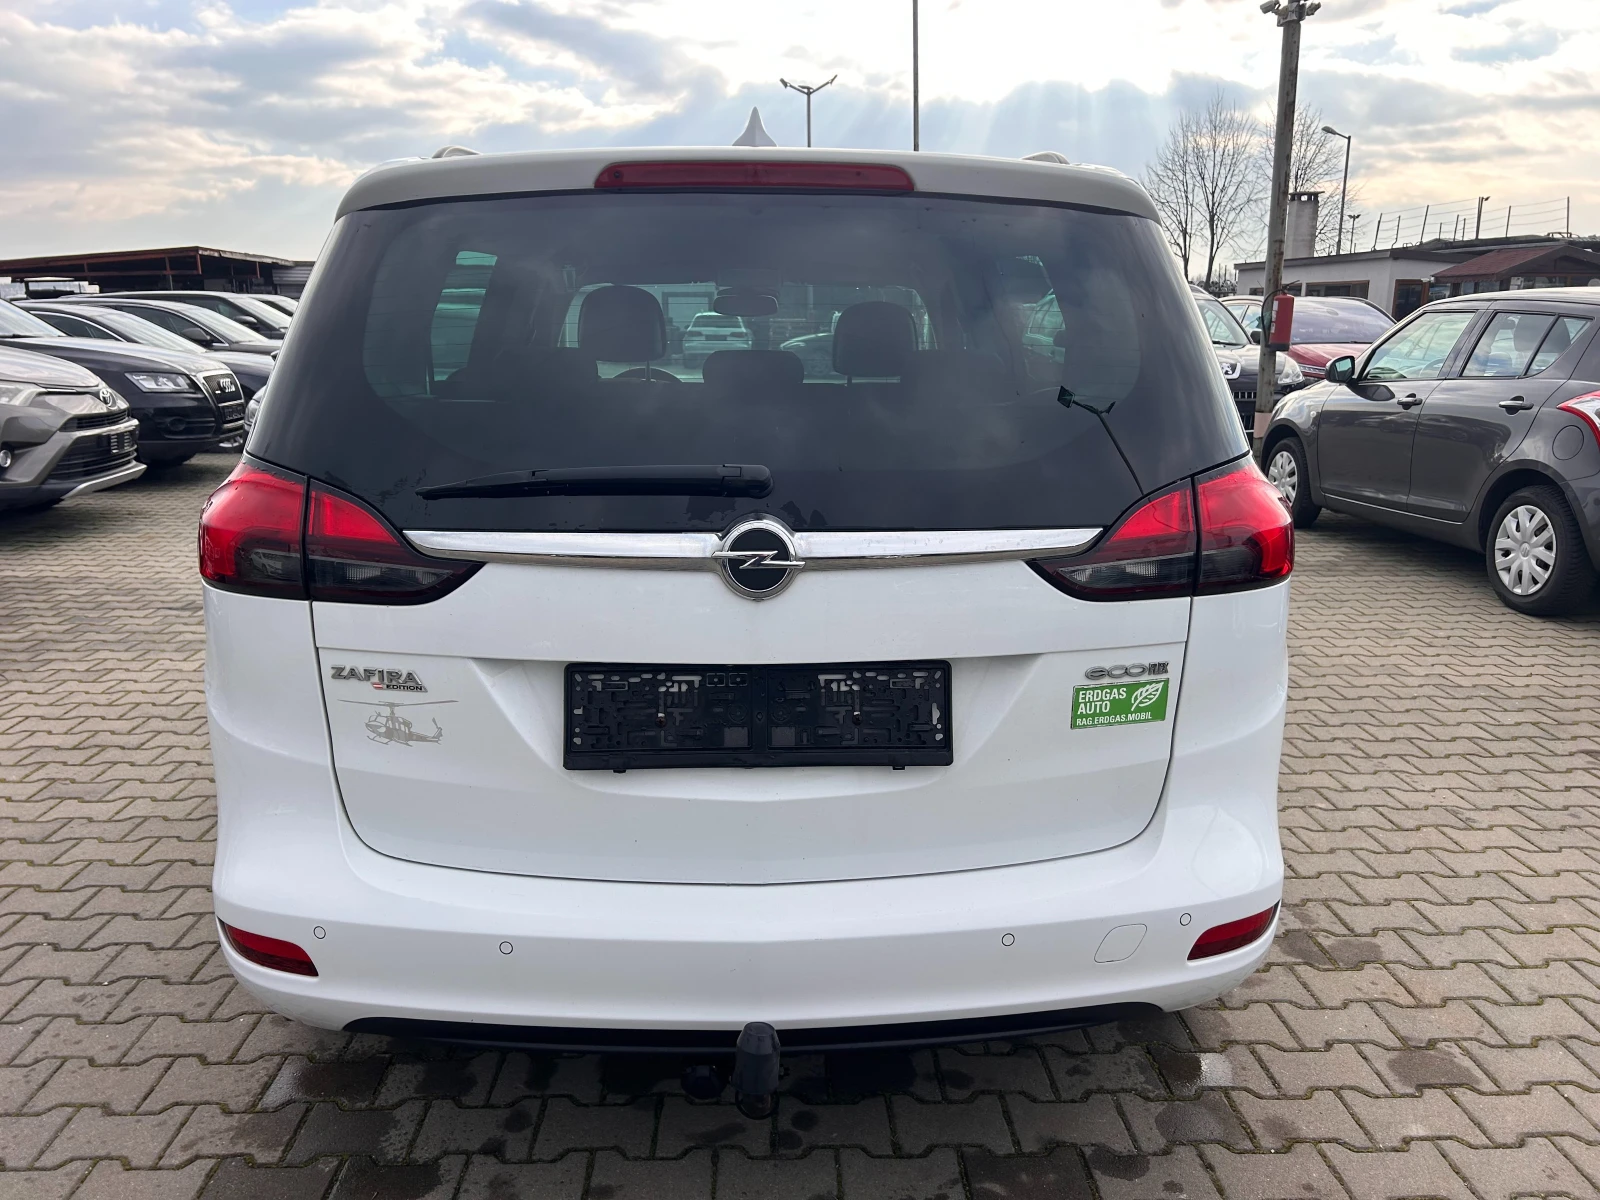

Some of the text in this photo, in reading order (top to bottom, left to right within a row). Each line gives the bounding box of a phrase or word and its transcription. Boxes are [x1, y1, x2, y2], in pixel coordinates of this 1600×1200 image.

[331, 665, 423, 685] ZAFIRA
[1078, 687, 1127, 702] ERDGAS
[1077, 701, 1110, 715] AUTO
[1076, 712, 1153, 726] RAG.ERDGAS.MOBIL
